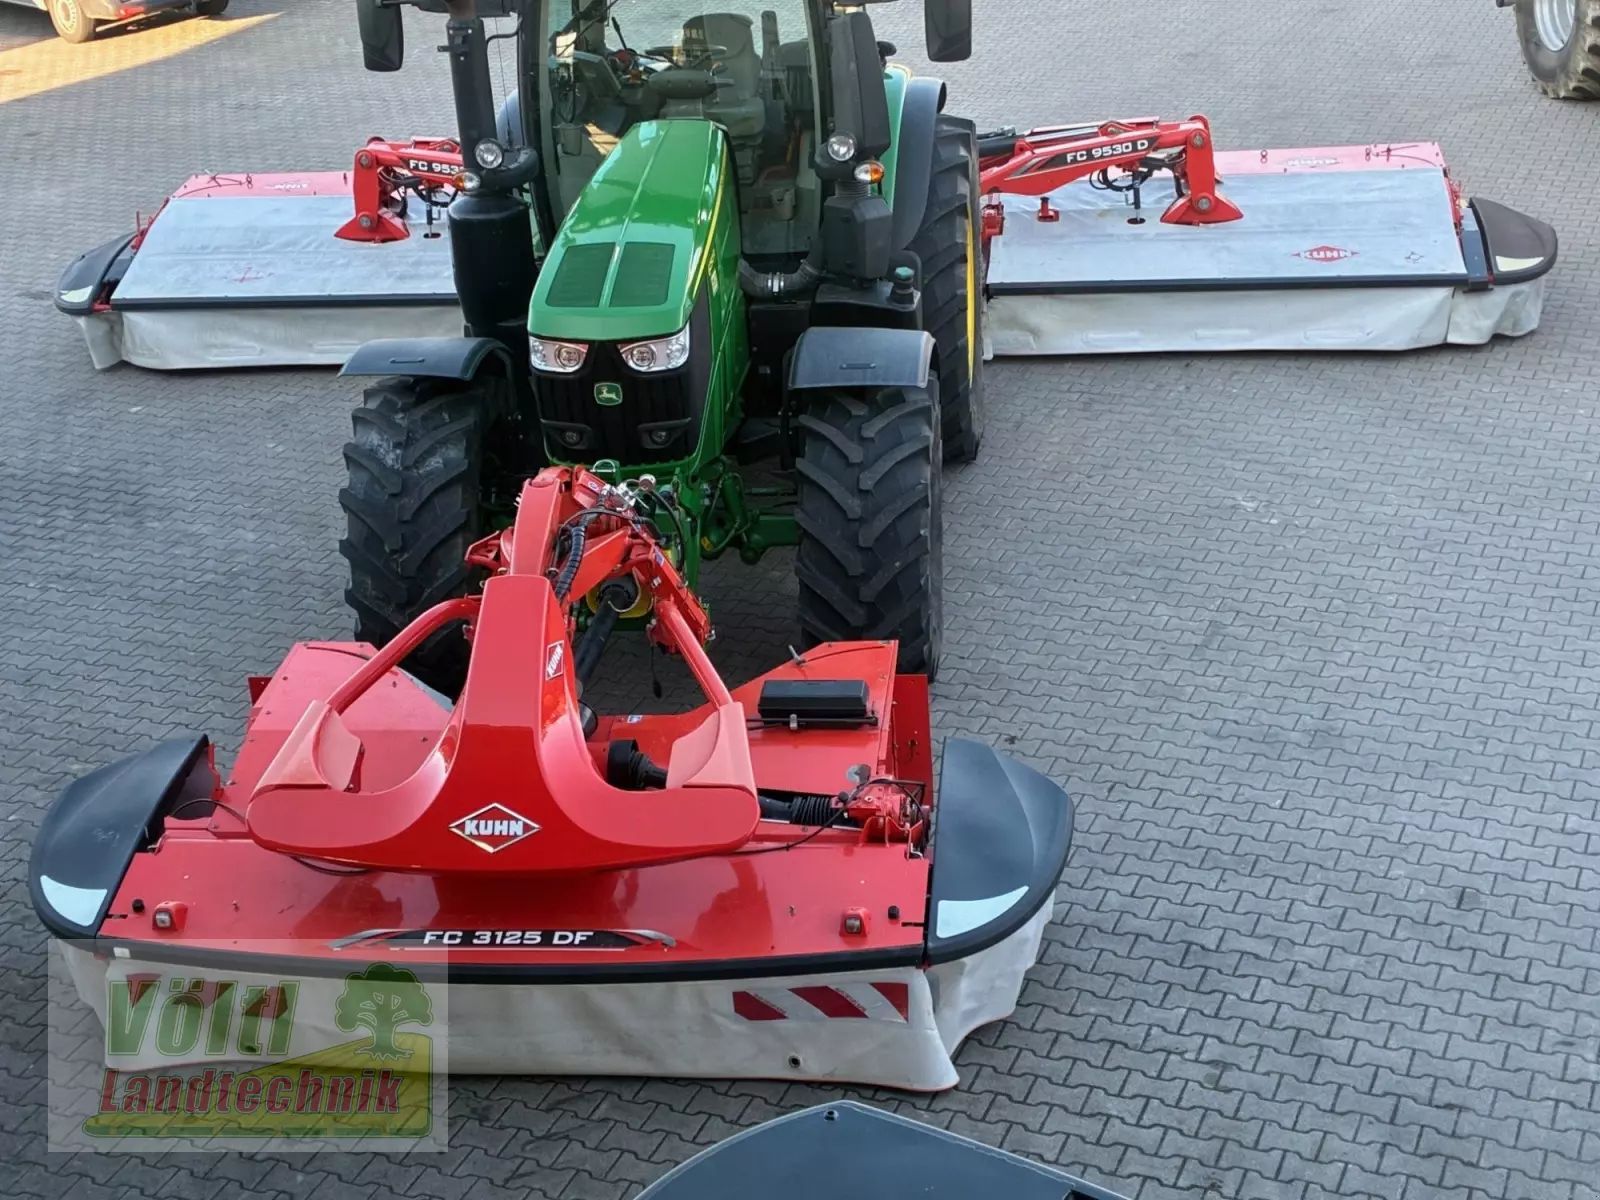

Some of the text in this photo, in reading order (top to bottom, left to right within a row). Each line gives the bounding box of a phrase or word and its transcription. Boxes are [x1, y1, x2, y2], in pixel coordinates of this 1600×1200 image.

[1066, 139, 1149, 164] FC 9530 D
[409, 159, 464, 175] FC 953
[1299, 250, 1352, 259] KUHN
[547, 643, 563, 677] KUHN
[464, 819, 524, 836] KUHN
[423, 931, 594, 945] FC 3125 DF
